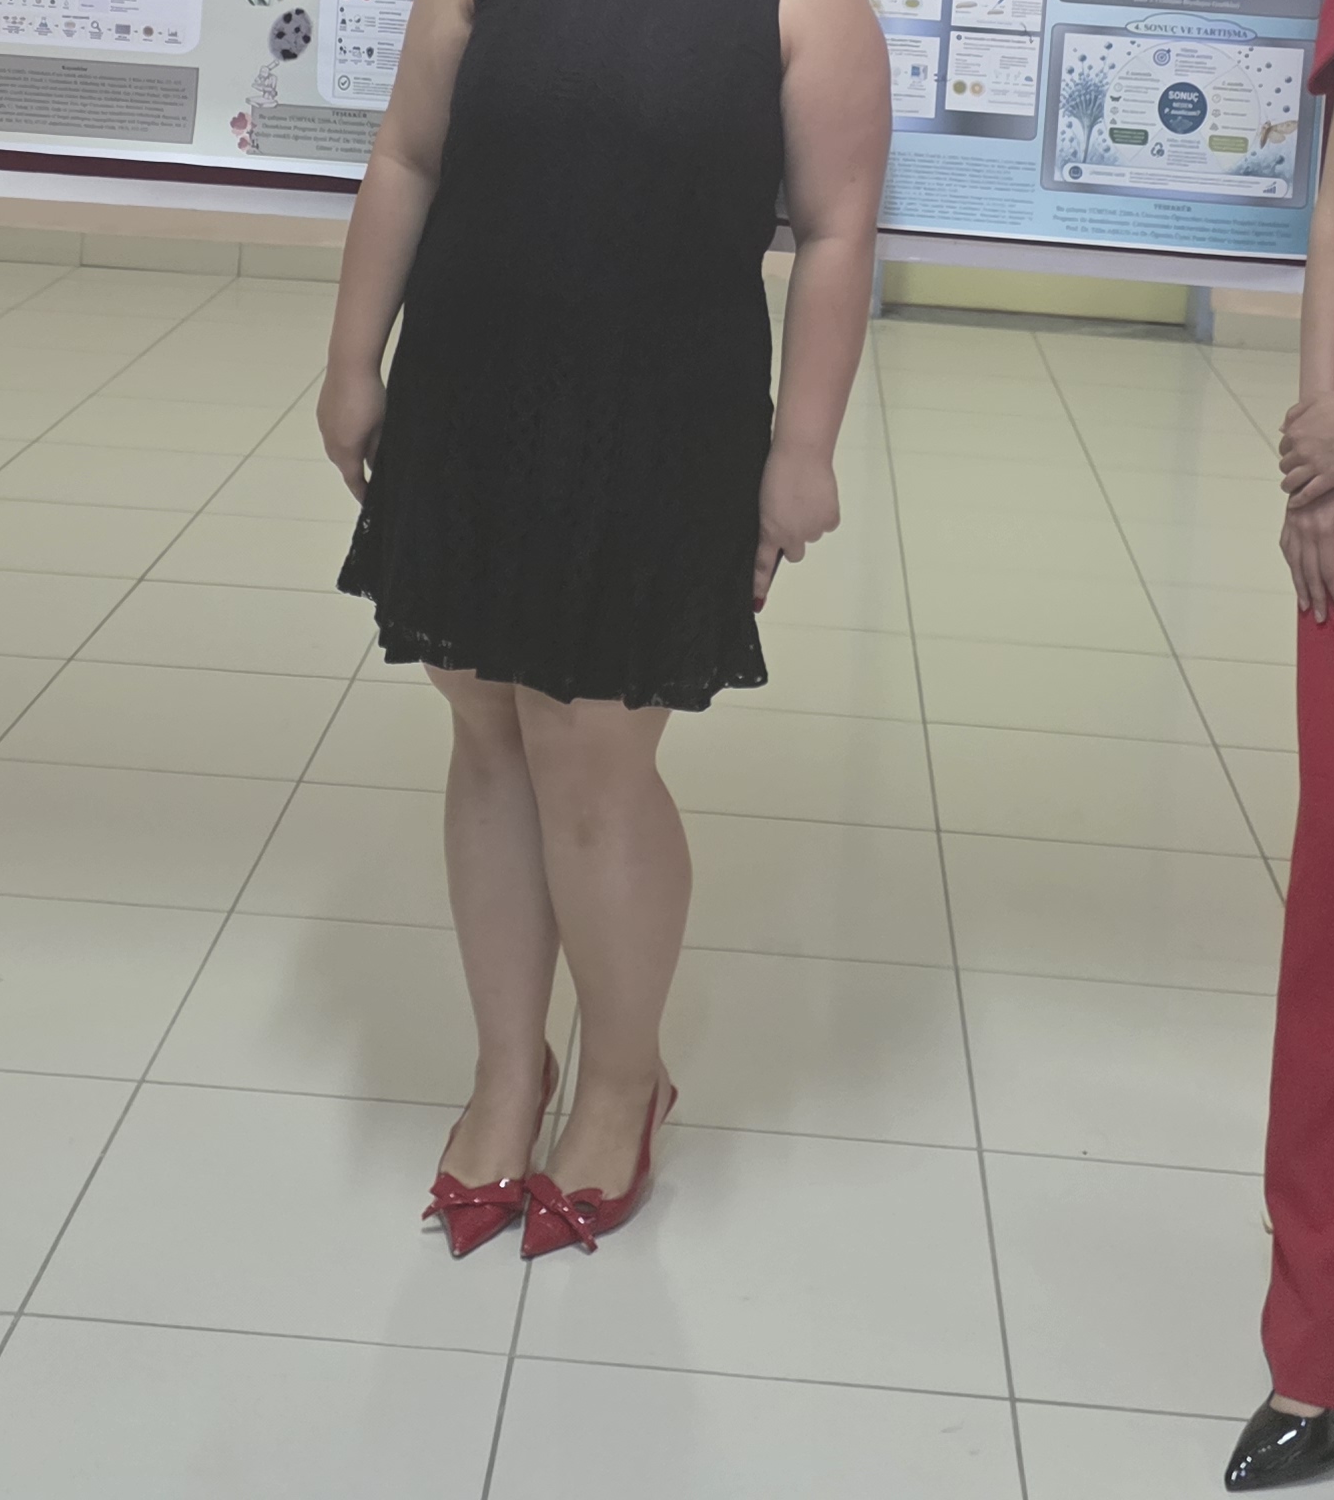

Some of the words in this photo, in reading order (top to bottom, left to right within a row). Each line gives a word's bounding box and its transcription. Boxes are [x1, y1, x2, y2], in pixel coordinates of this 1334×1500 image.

[1144, 24, 1177, 34] SONUÇ
[1180, 26, 1194, 34] VE
[1197, 27, 1248, 39] TARTIŞMA
[1168, 90, 1199, 102] SONUÇ
